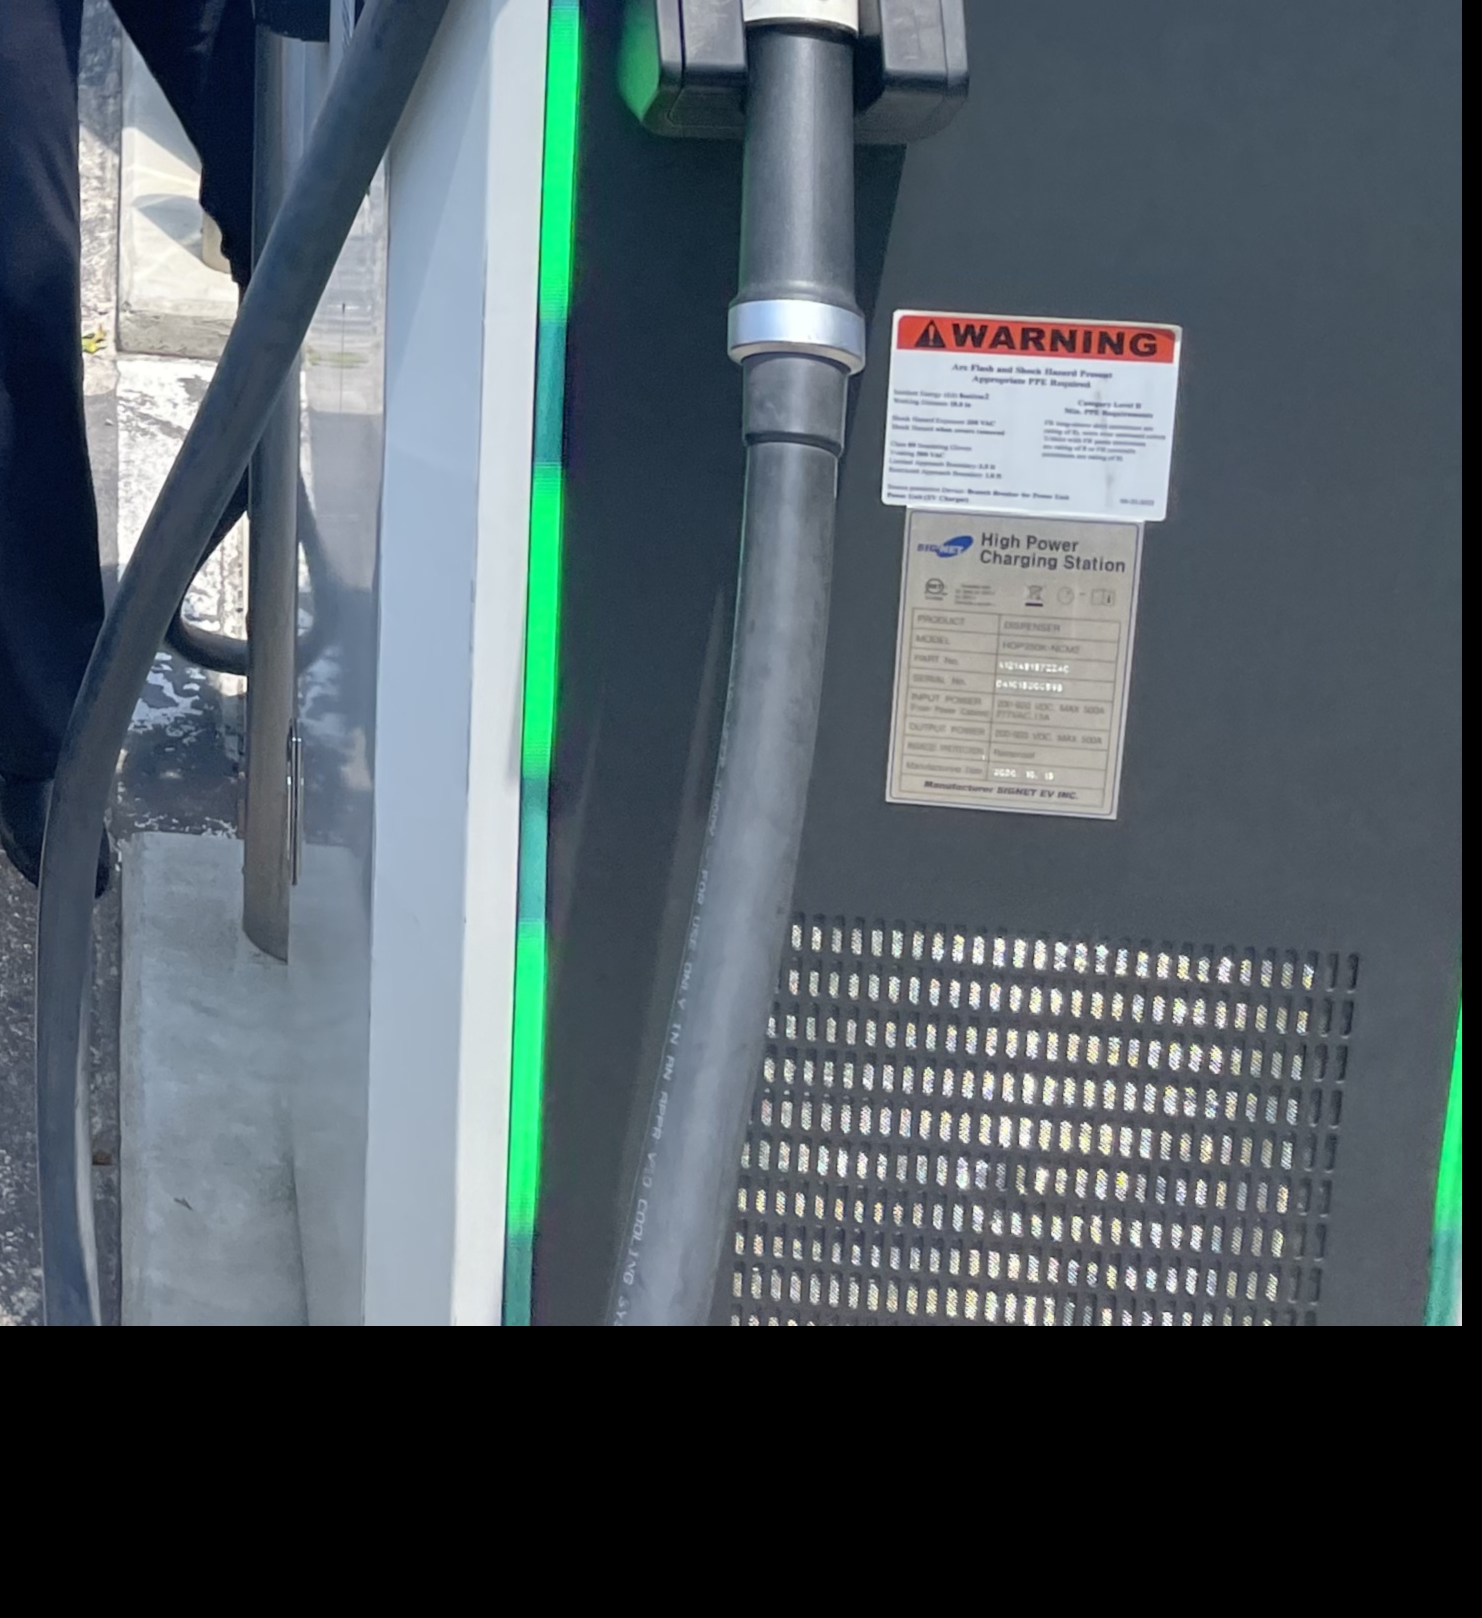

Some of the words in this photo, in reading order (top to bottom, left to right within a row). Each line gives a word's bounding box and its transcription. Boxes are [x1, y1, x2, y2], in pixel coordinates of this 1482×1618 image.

[952, 323, 1157, 357] WARNING
[952, 363, 967, 371] Arc
[970, 364, 993, 372] Flash
[996, 365, 1012, 373] and
[1015, 367, 1041, 375] Shock
[1044, 368, 1077, 377] Hazard
[1080, 370, 1112, 379] Present
[972, 375, 1025, 386] Appropriate
[1028, 378, 1046, 386] PPE
[1050, 379, 1090, 390] Required
[980, 533, 1020, 550] High
[1026, 535, 1078, 552] Power
[979, 549, 1057, 569] Charging
[1063, 555, 1125, 572] Station
[917, 614, 965, 625] PRODUCT
[1003, 620, 1060, 632] DISPENSER
[915, 634, 950, 644] MODEL
[914, 653, 938, 662] PART
[911, 692, 939, 702] INPUT
[944, 695, 981, 705] POWER
[924, 780, 992, 792] Manufacturer
[997, 786, 1036, 796] SIGNET
[1039, 789, 1054, 797] EV
[1057, 791, 1078, 799] INC.
[694, 869, 709, 905] FOR
[675, 960, 693, 1010] ONLY
[668, 1021, 681, 1046] IN
[661, 1054, 675, 1080] AN
[621, 1198, 649, 1285] COOLING
